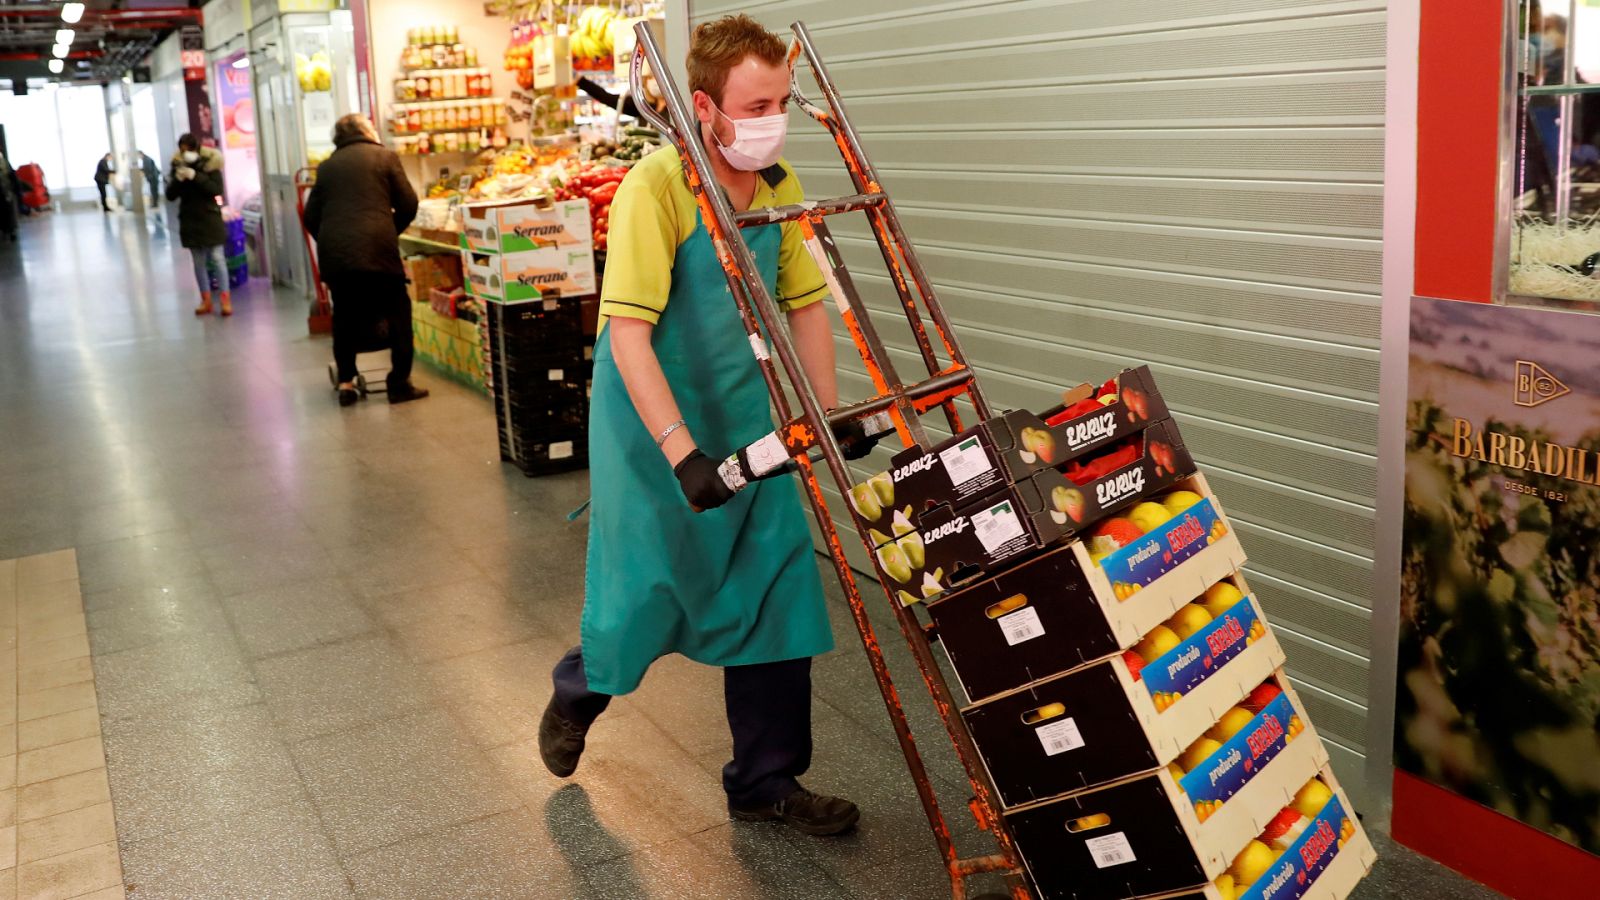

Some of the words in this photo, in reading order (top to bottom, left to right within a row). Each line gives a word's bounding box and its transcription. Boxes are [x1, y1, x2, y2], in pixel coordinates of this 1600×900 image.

[513, 223, 565, 240] Serrano
[516, 271, 569, 287] Serrano
[1520, 375, 1530, 391] B
[1066, 412, 1118, 446] ERRUZ
[893, 452, 938, 483] ERRUZ
[1096, 467, 1146, 504] ERRUZ
[1504, 481, 1538, 496] DESDE
[1543, 490, 1568, 503] 1821
[924, 515, 969, 546] ERRUZ
[1127, 539, 1161, 572] producido
[1165, 513, 1206, 554] ESPAÑA
[1167, 645, 1201, 680] producido
[1205, 614, 1246, 658] ESPAÑA
[1208, 748, 1242, 787] producido
[1245, 713, 1285, 760] ESPAÑA
[1261, 861, 1296, 900] producido
[1299, 818, 1337, 871] ESPAÑA
